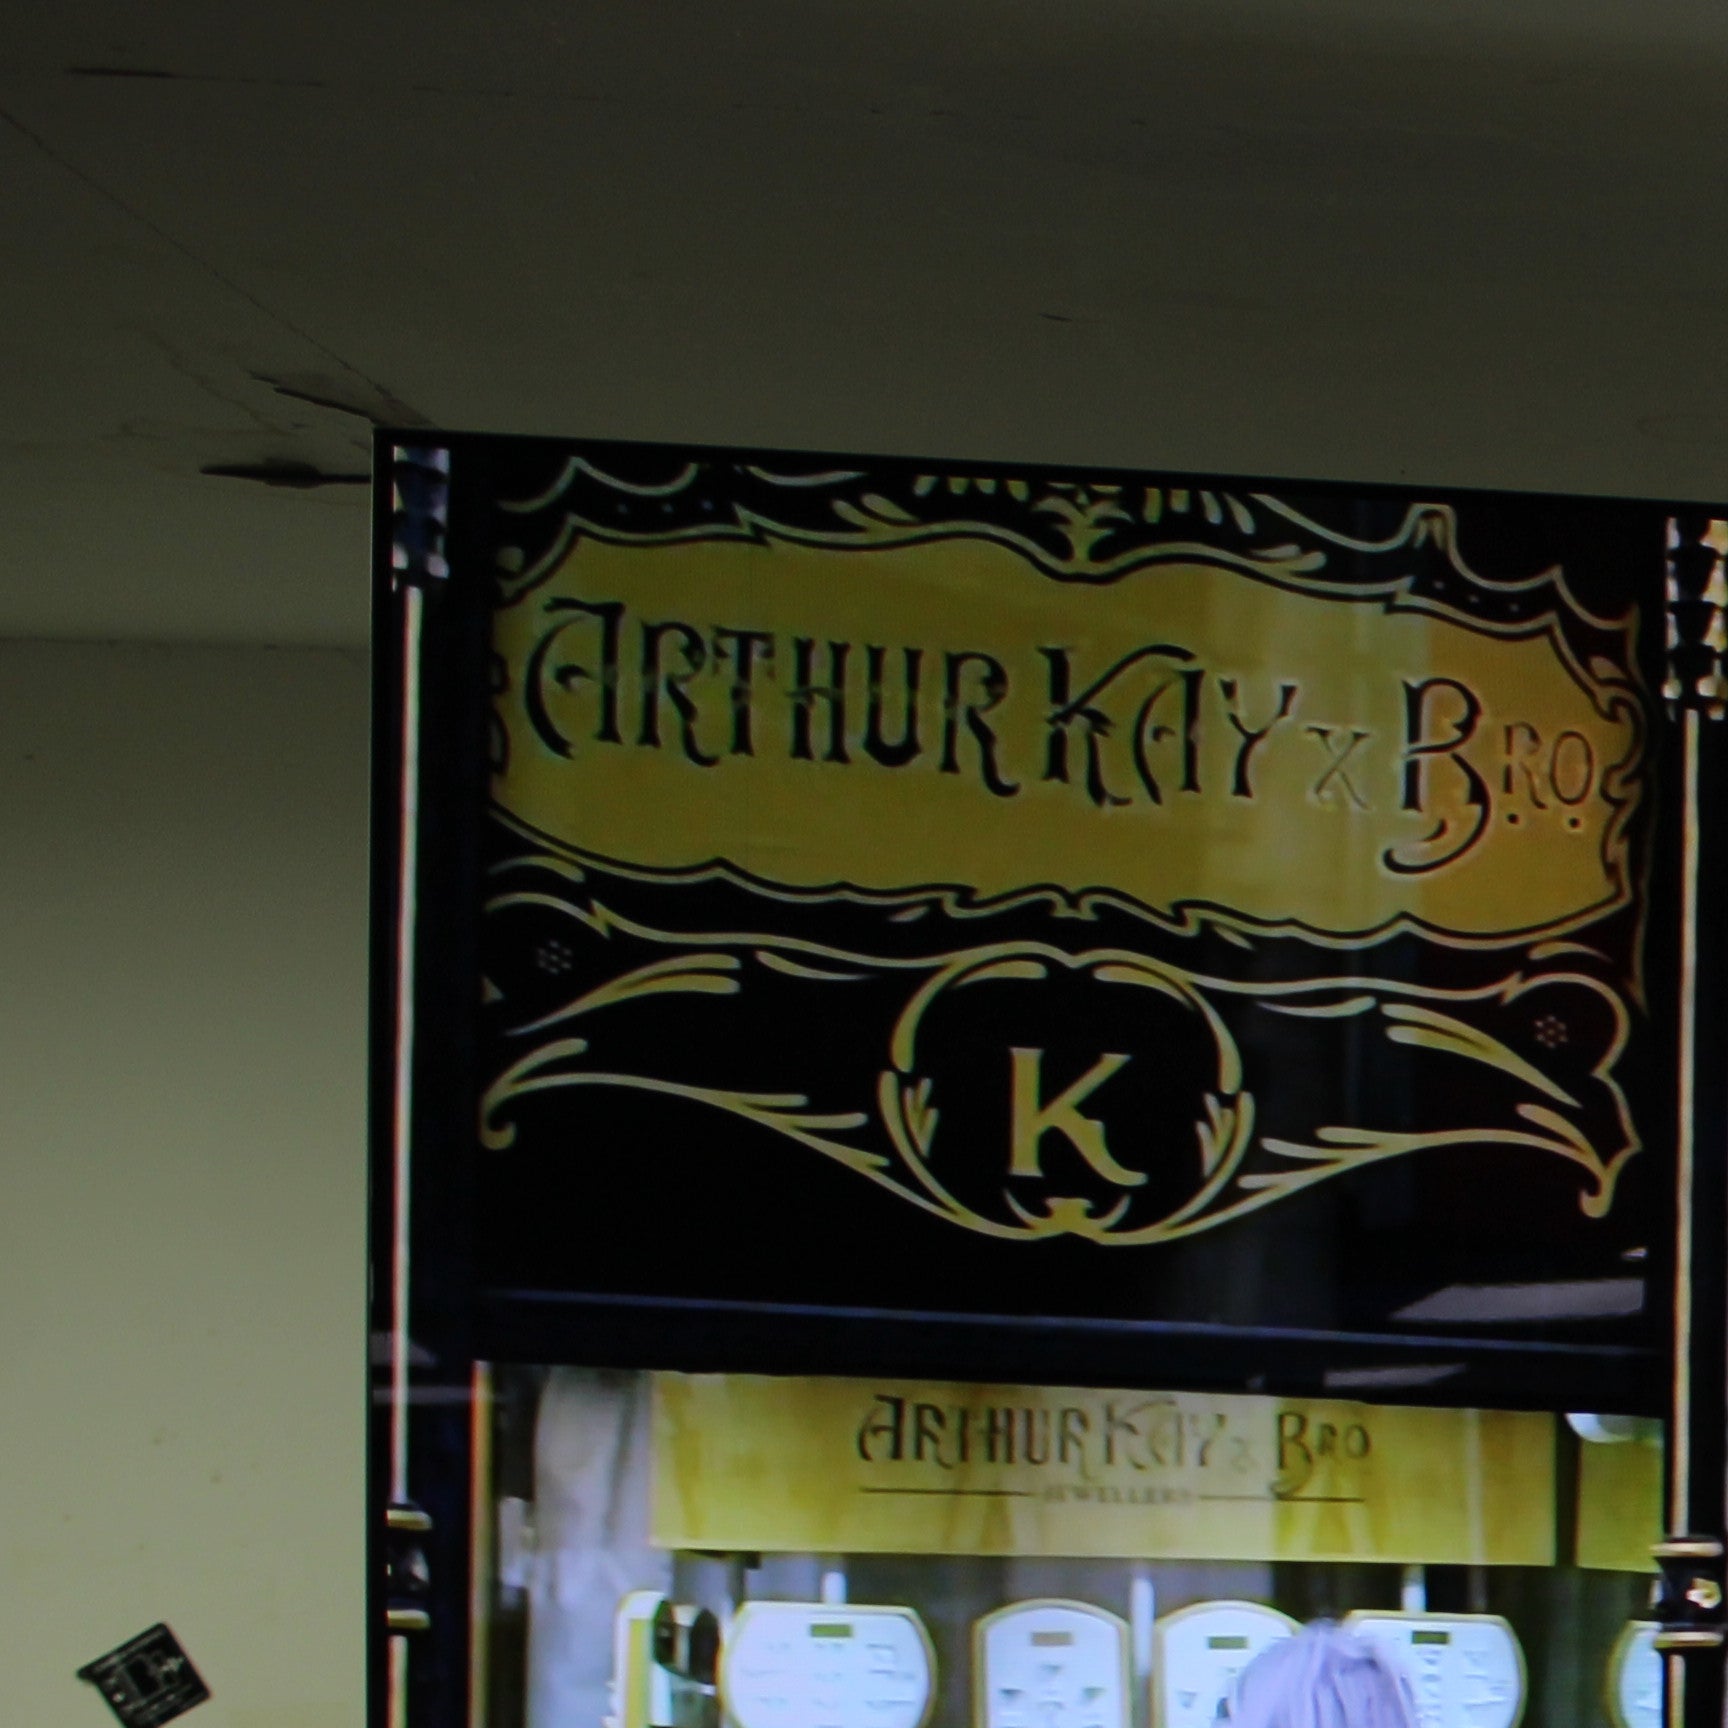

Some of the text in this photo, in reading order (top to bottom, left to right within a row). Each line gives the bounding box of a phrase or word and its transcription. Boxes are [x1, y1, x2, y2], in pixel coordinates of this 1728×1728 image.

[524, 596, 1021, 798] ARTHUR
[1037, 643, 1298, 806] KAY
[1009, 1046, 1146, 1186] K
